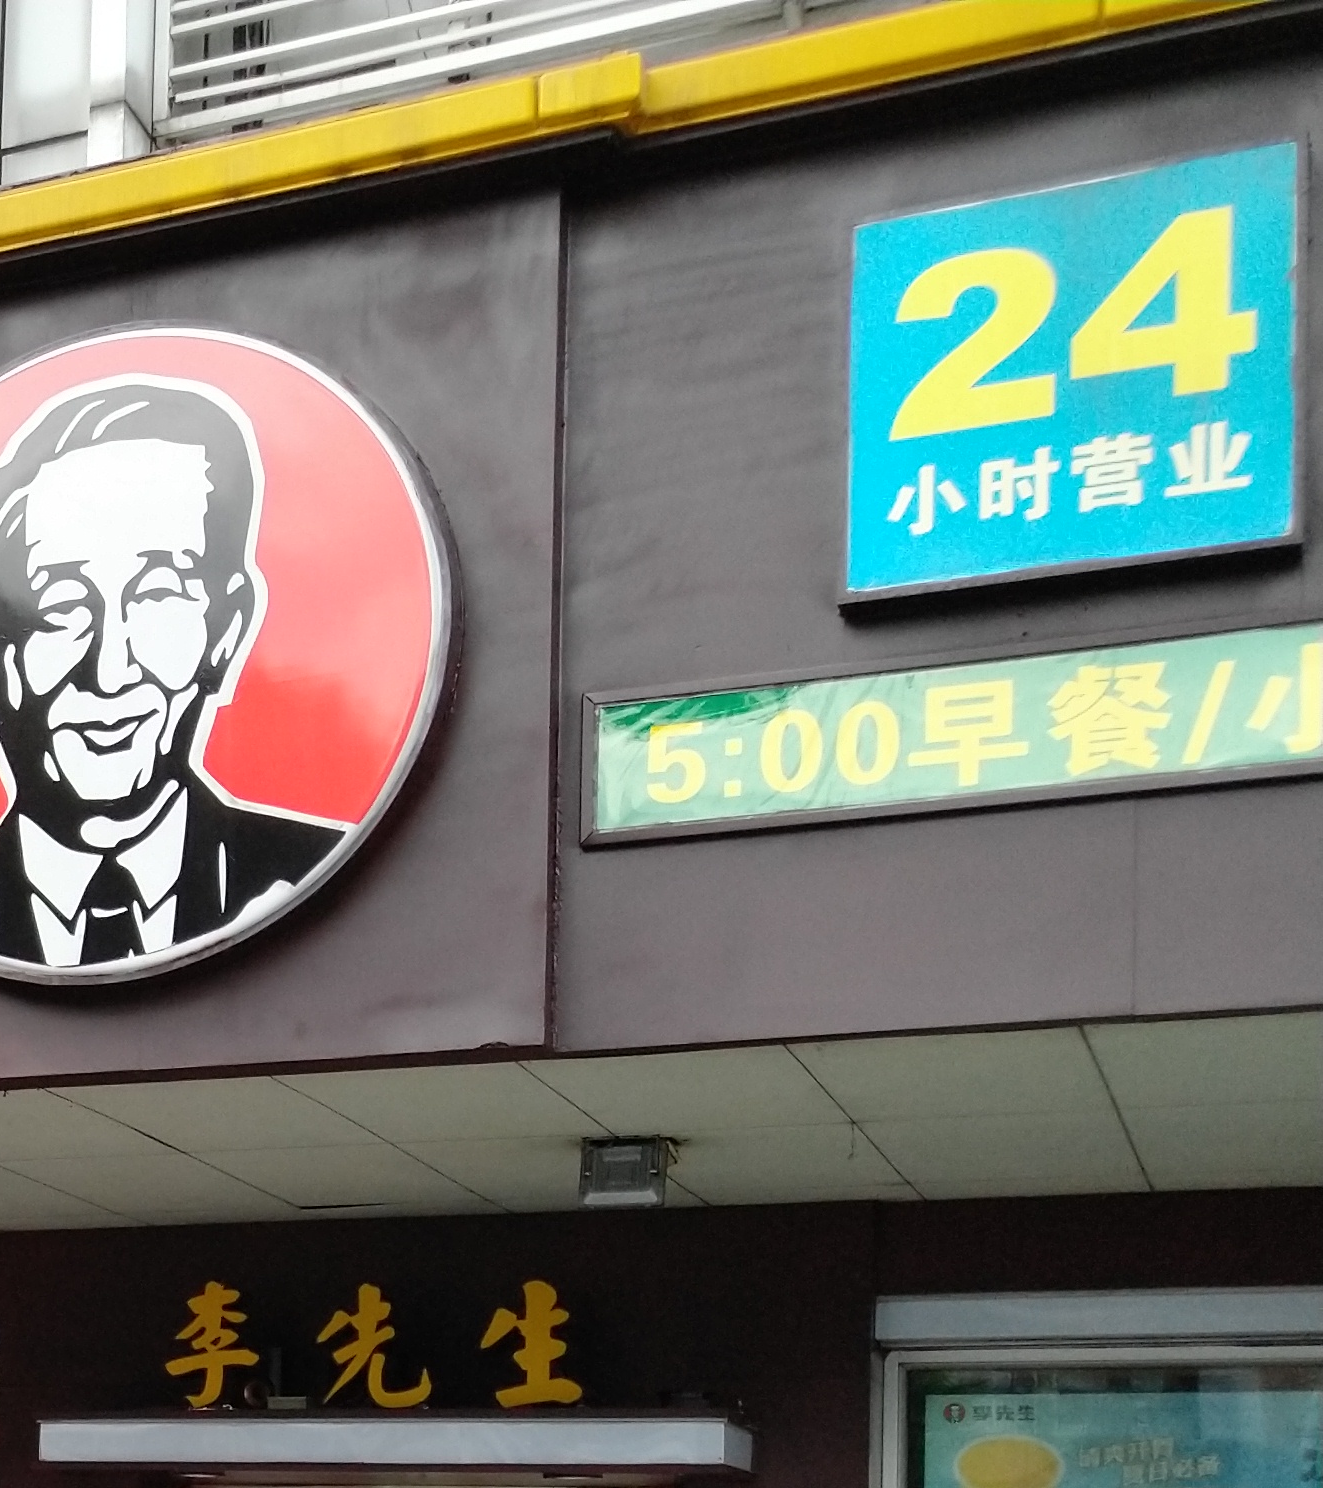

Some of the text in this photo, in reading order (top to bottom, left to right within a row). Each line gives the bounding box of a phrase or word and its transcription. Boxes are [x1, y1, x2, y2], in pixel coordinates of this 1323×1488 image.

[888, 205, 1257, 442] 24
[887, 420, 1252, 536] 小时营业
[165, 1280, 583, 1409] 李先生
[973, 1405, 1036, 1421] 李先生
